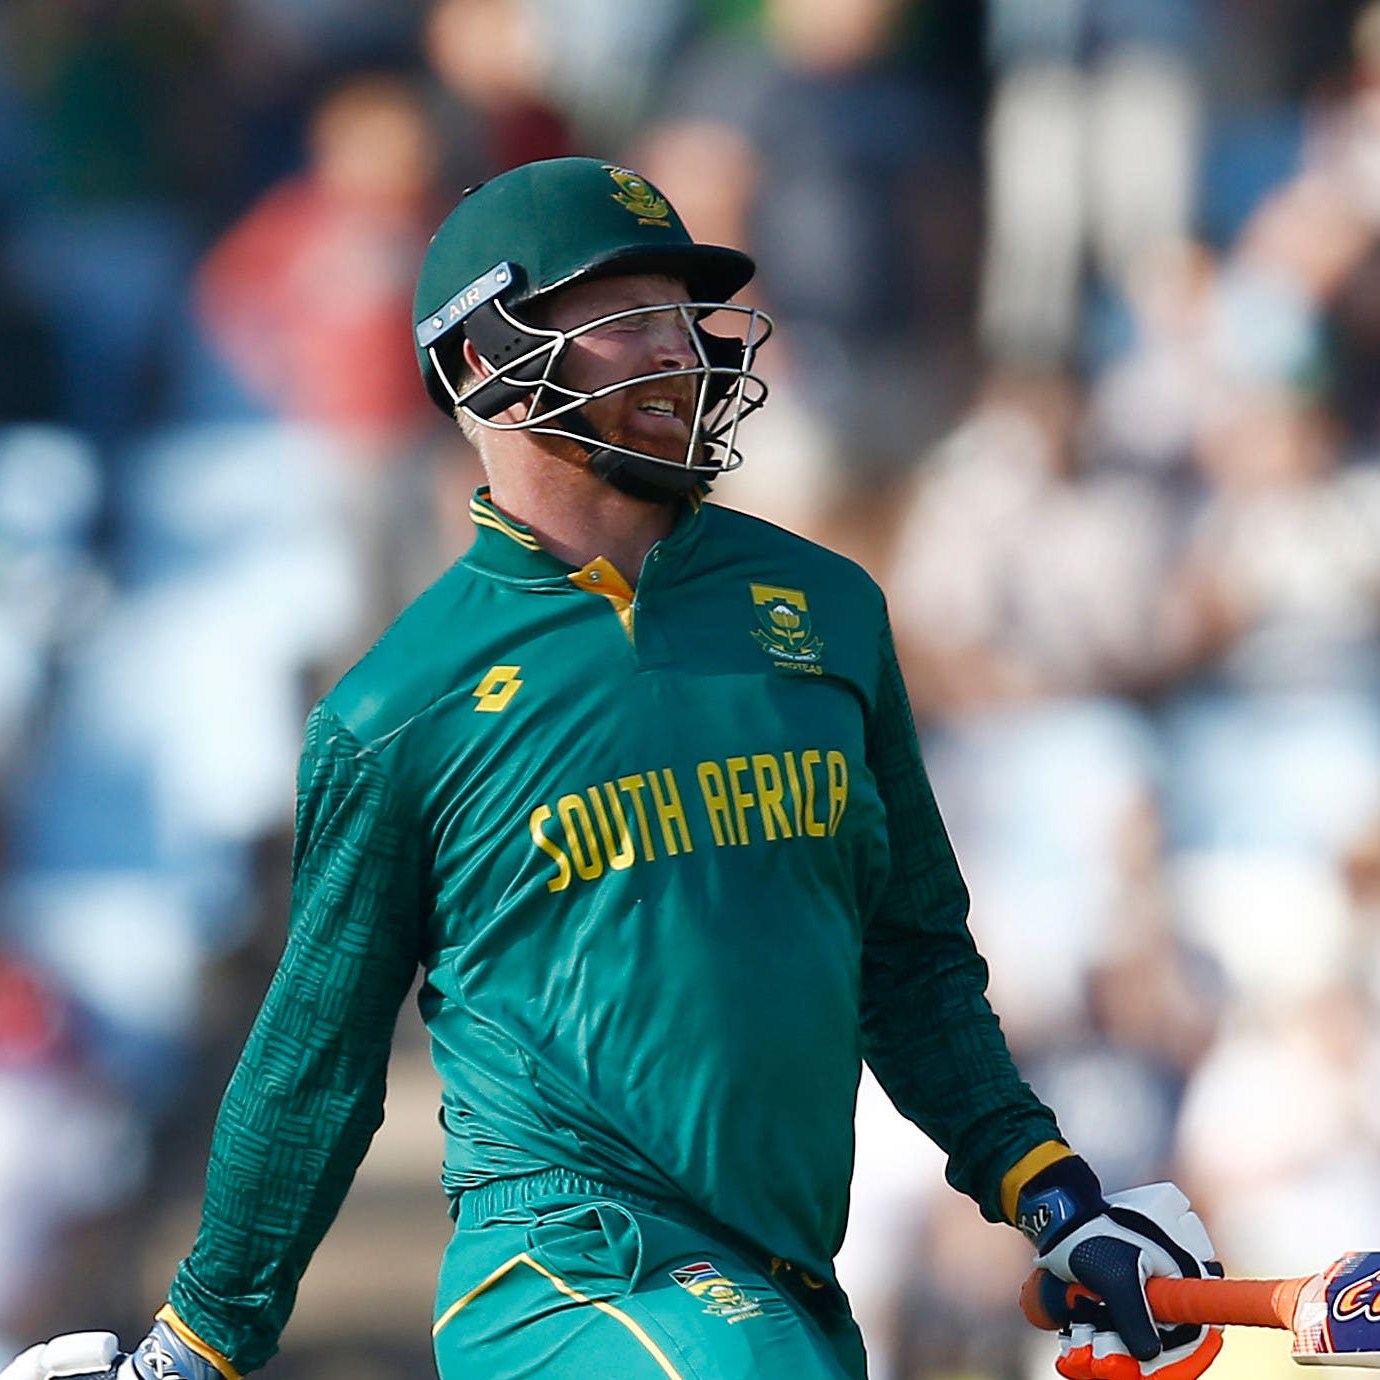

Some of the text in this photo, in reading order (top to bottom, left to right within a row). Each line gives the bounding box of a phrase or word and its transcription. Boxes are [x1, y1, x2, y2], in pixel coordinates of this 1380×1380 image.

[448, 287, 480, 320] AIR
[529, 749, 848, 893] SOUTH AFRICA
